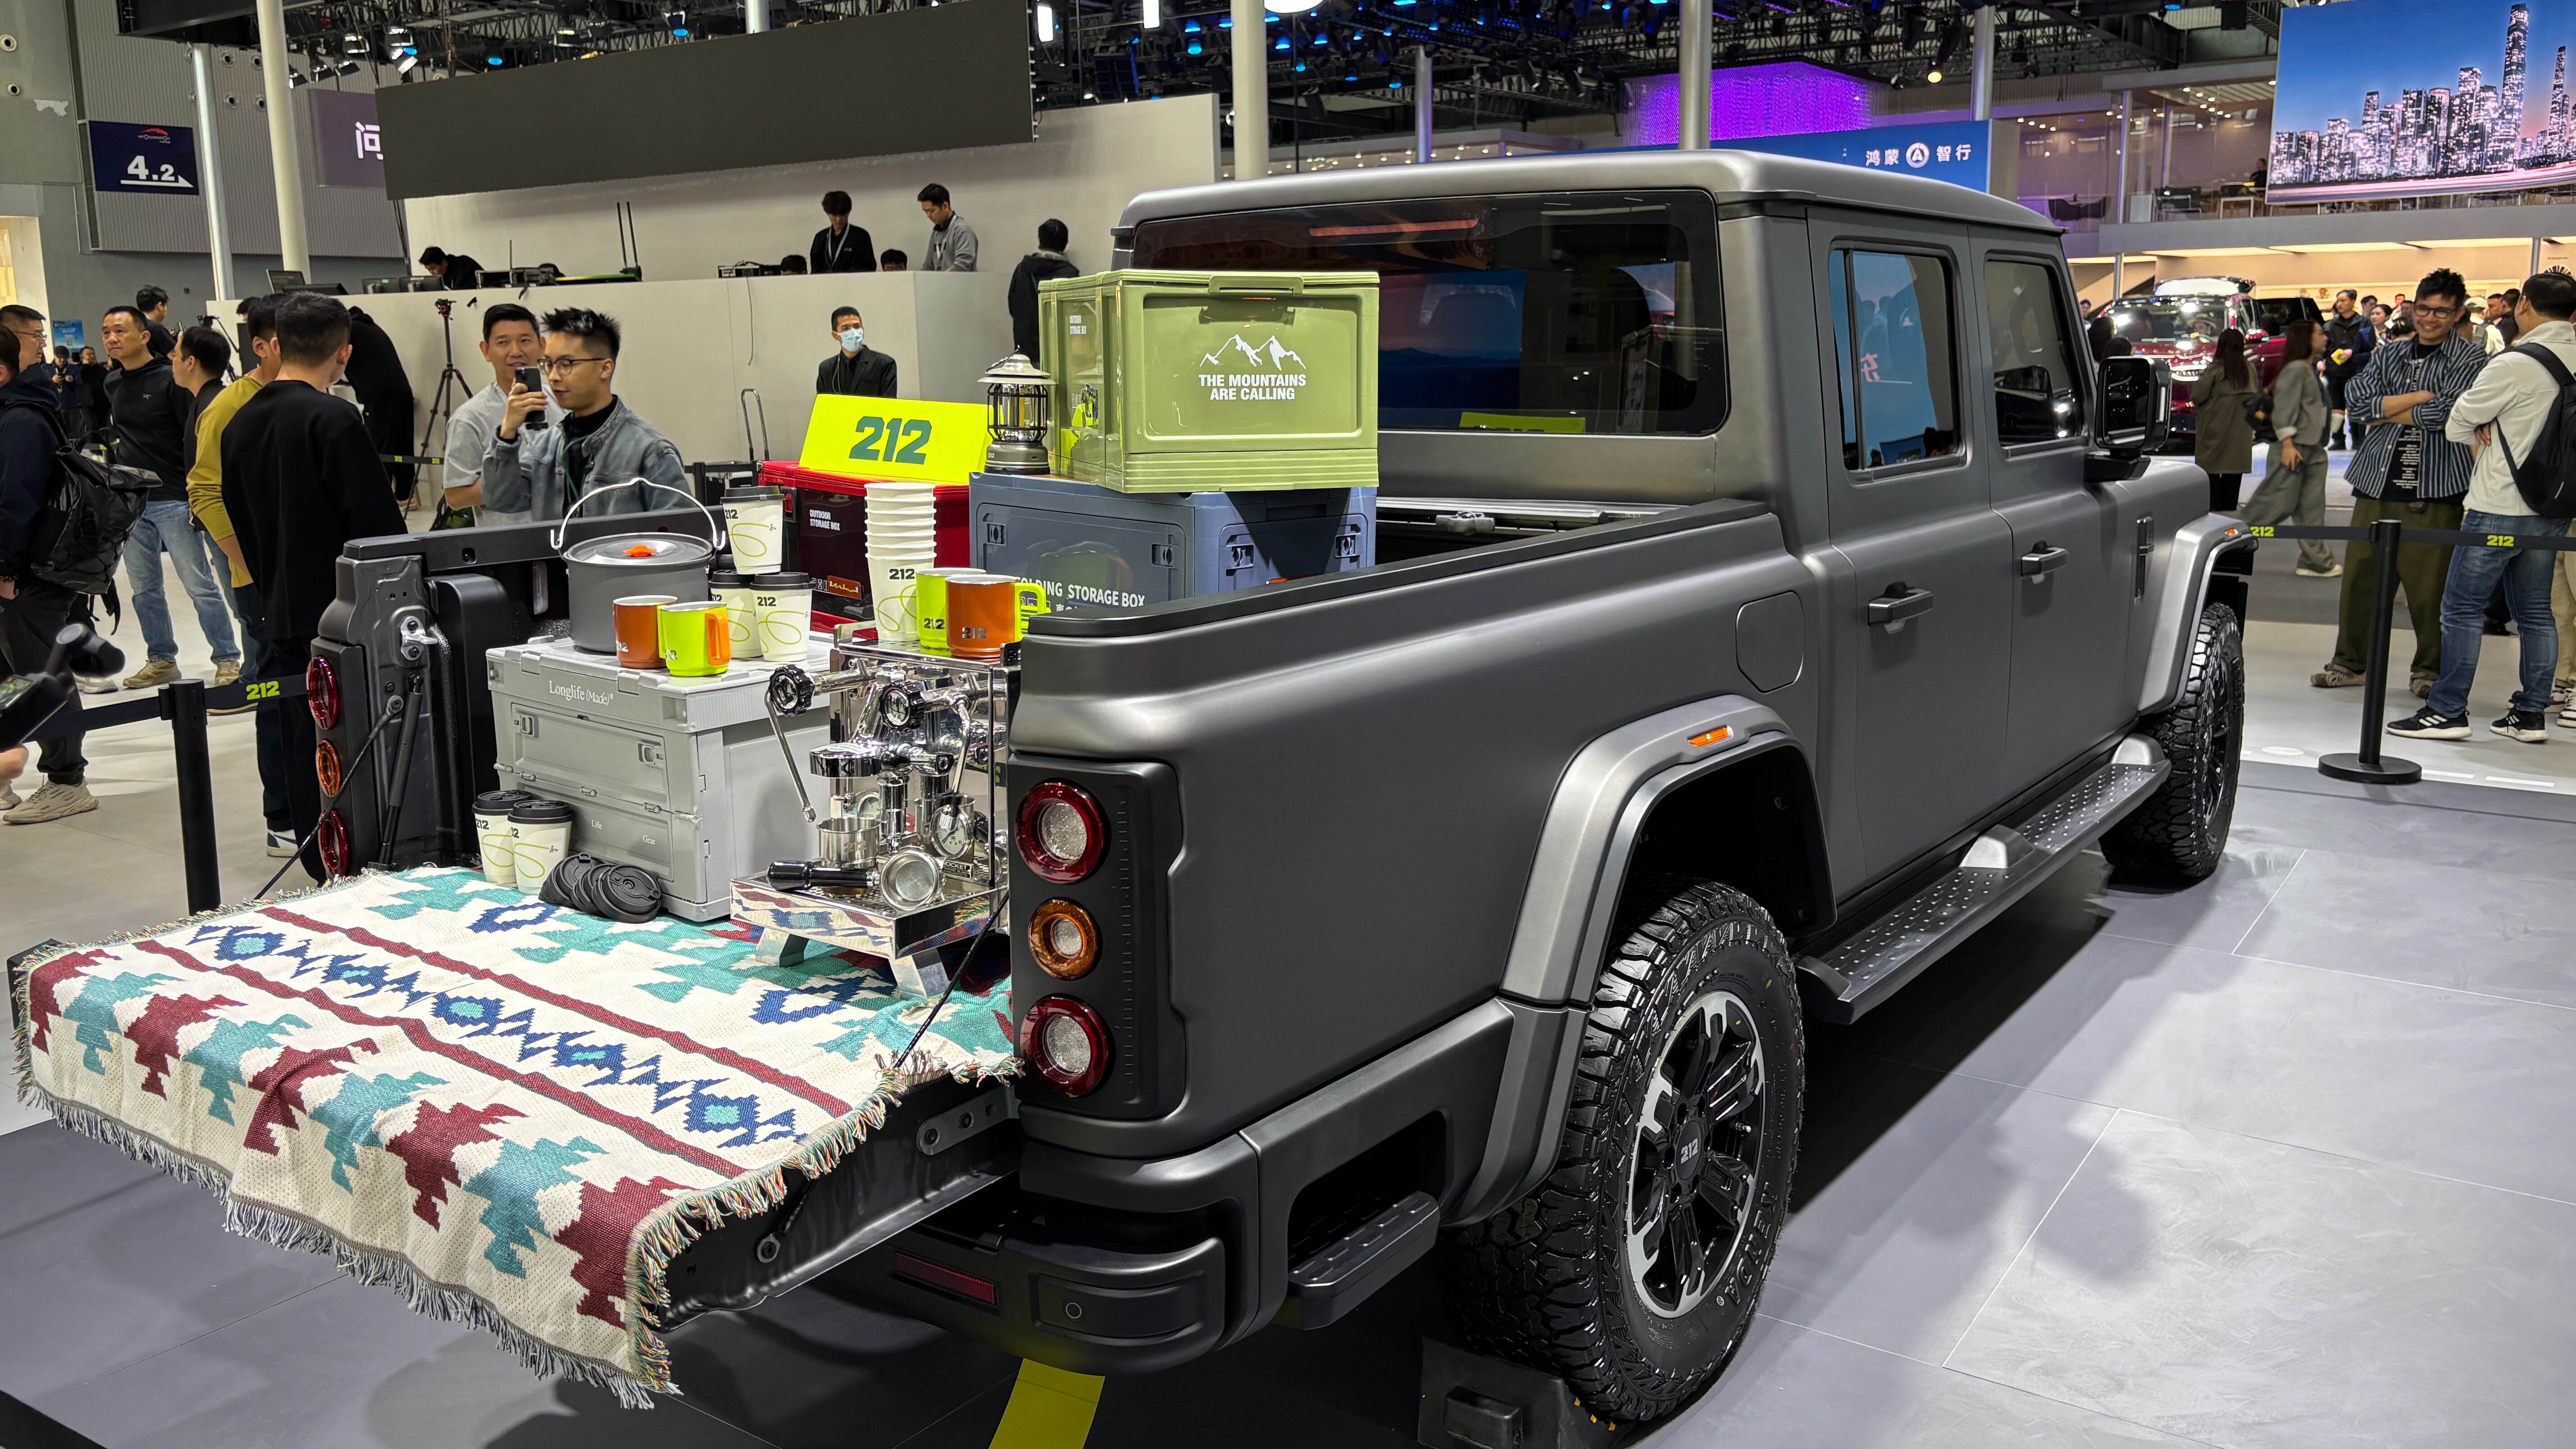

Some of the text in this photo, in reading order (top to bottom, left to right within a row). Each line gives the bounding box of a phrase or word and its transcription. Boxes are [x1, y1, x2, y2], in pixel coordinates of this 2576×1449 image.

[1866, 144, 1971, 166] 鸿蒙 智行
[127, 155, 175, 181] 4.2
[1198, 374, 1306, 386] THE MOUNTAINS
[1210, 388, 1295, 400] ARE CALLING
[849, 416, 932, 465] 212
[725, 509, 739, 519] 212
[810, 509, 831, 520] OUTDOOR
[810, 518, 840, 531] STORAGE BOX
[2250, 526, 2274, 537] 212
[2487, 535, 2514, 547] 212
[889, 568, 915, 580] 212
[757, 596, 777, 607] 212
[1067, 584, 1119, 606] STORAGE
[1122, 592, 1145, 607] BOX
[924, 617, 945, 630] 212
[962, 627, 987, 639] 212
[246, 681, 280, 700] 212
[549, 680, 585, 701] Longlife
[591, 819, 602, 829] Life
[643, 835, 656, 845] Gear
[844, 840, 866, 852] 212
[1681, 1138, 1698, 1164] 212
[1725, 1182, 1778, 1305] KENDA
